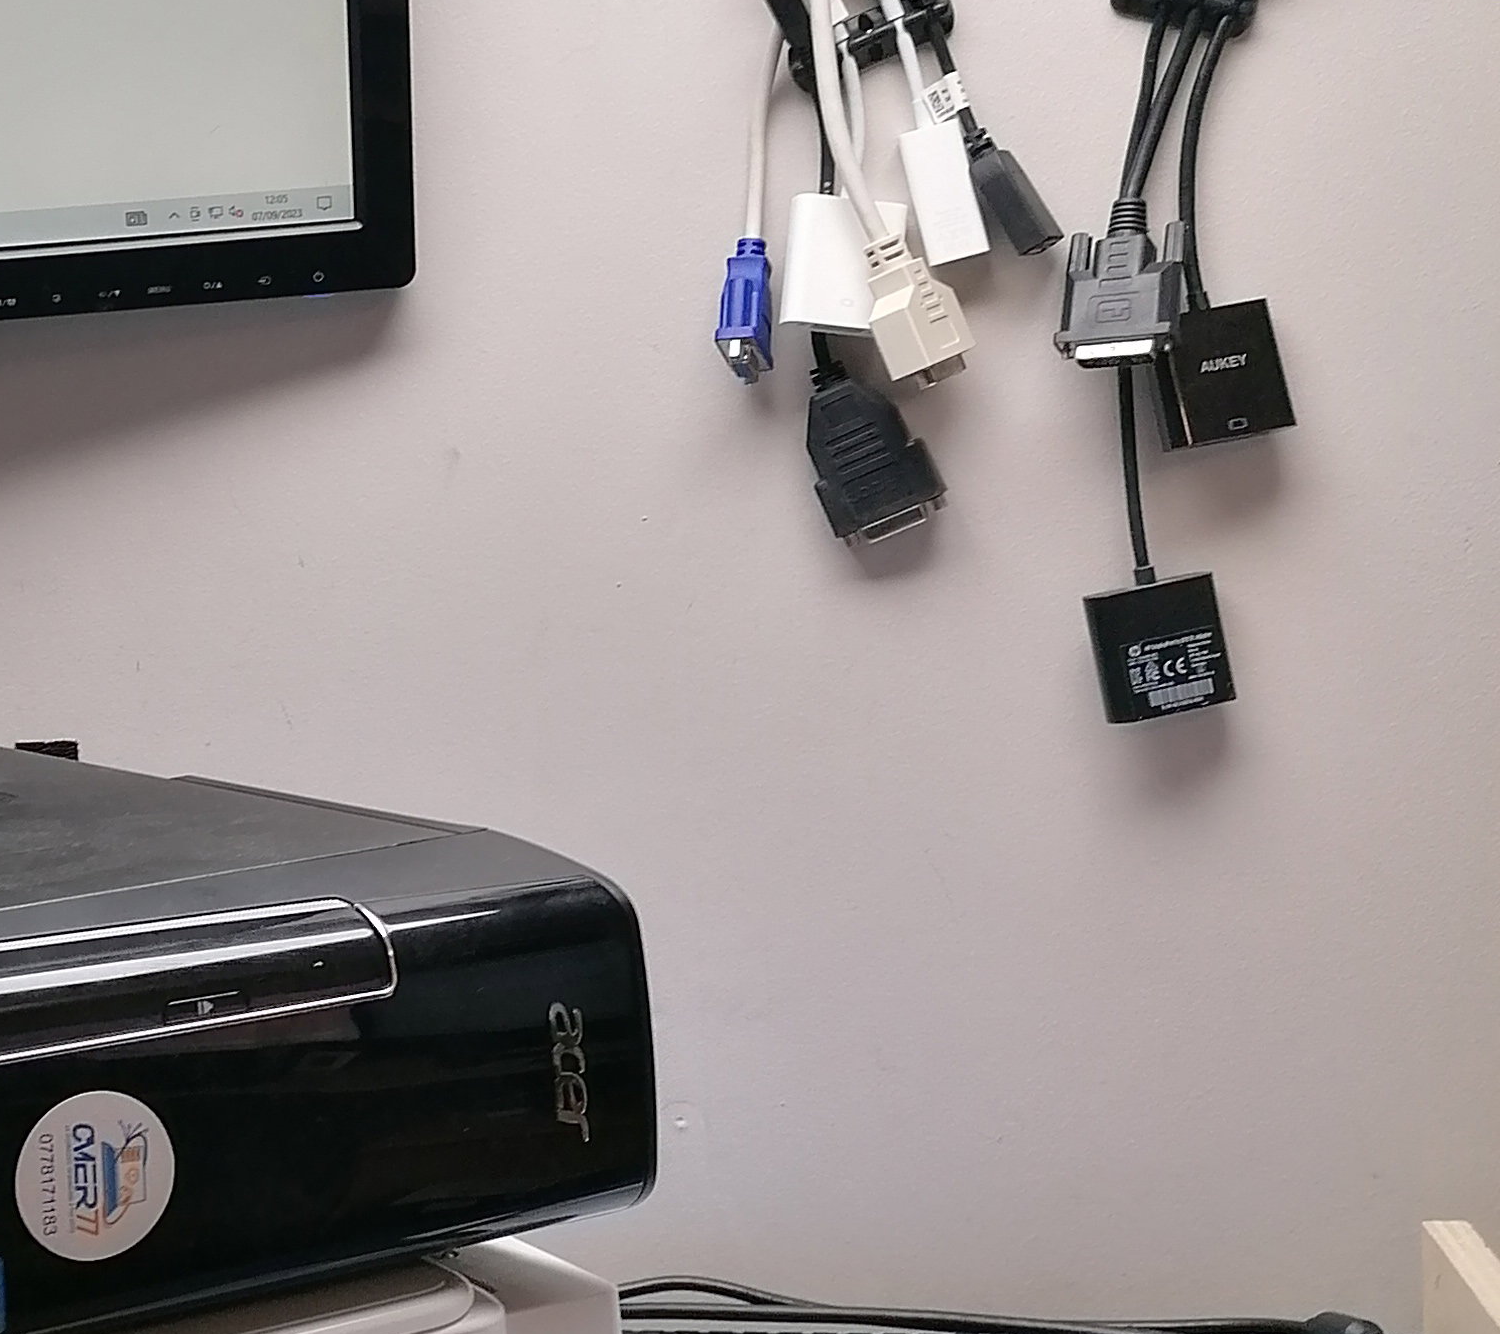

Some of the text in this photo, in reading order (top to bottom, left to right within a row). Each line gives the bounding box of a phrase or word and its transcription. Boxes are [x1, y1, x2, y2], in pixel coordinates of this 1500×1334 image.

[1199, 352, 1248, 375] AUKEY
[547, 1000, 592, 1144] acer
[38, 1132, 58, 1237] 0778171183
[71, 1122, 100, 1238] CMER77
